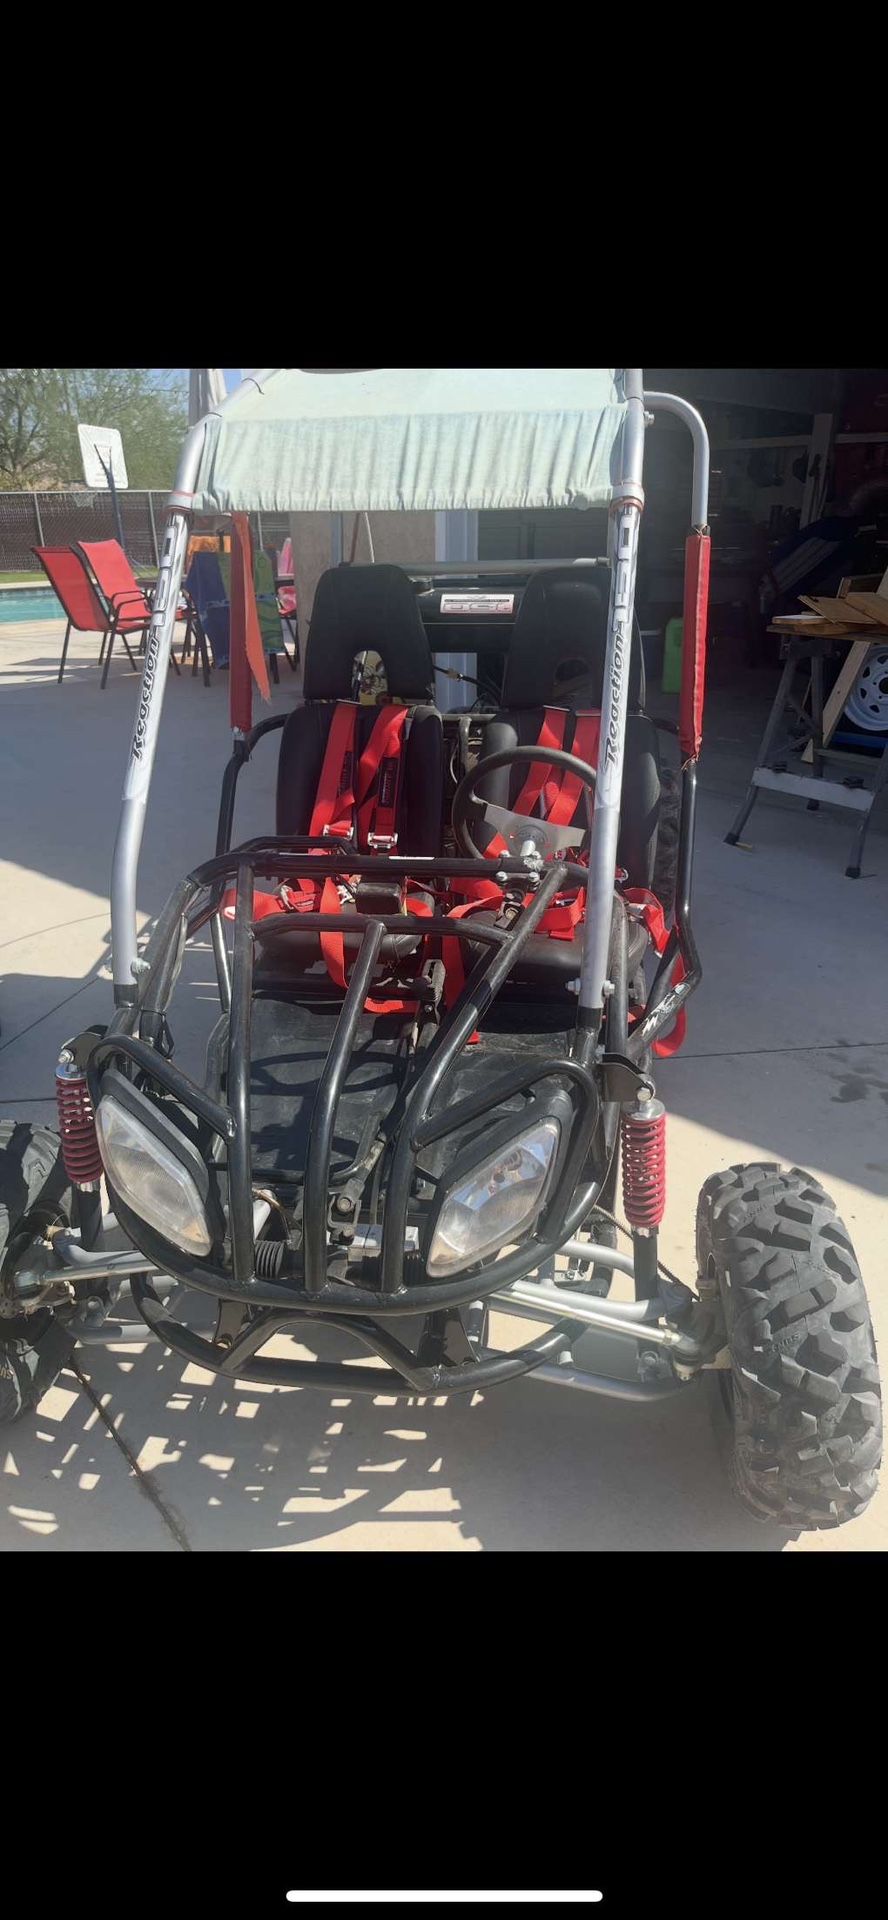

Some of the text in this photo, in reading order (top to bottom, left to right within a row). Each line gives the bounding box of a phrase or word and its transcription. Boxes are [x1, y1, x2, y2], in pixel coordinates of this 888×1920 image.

[132, 634, 160, 760] Reaction
[604, 514, 635, 769] Reaction 150
